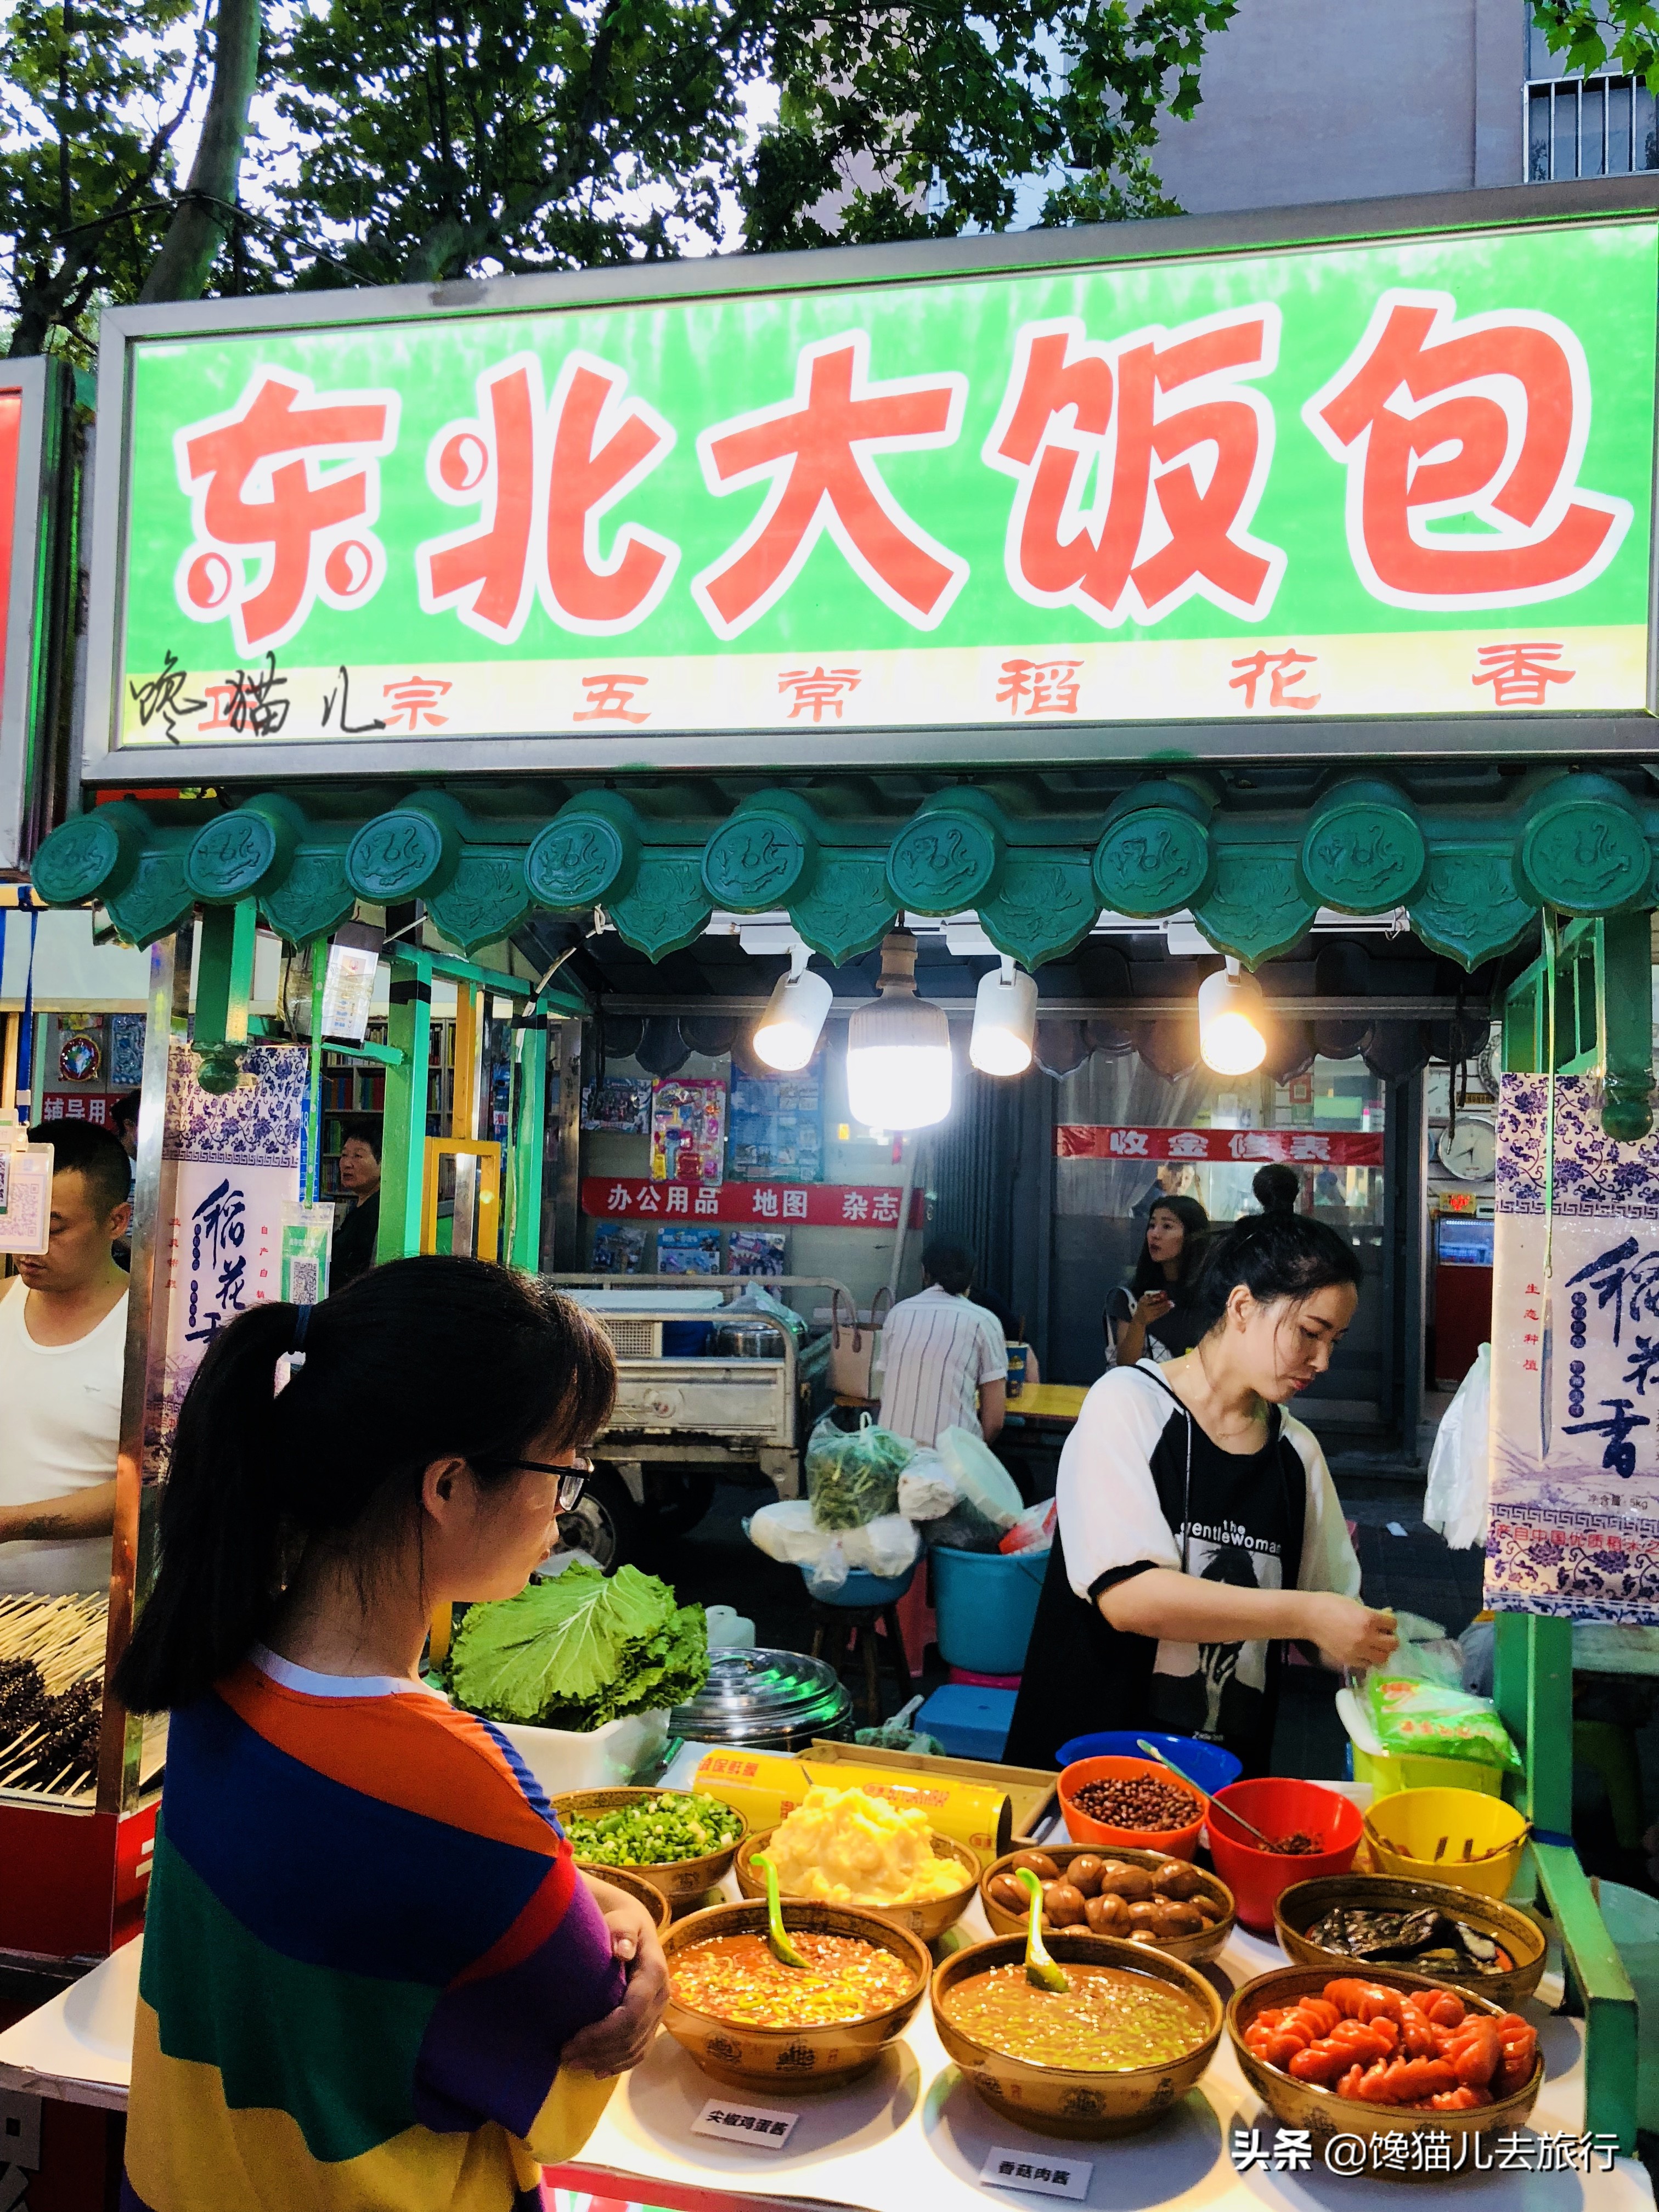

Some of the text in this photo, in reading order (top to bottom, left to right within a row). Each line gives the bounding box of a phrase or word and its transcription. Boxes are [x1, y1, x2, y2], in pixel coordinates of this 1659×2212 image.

[177, 289, 1632, 656] 东北大饭包
[198, 644, 1576, 732] 正宗五常稻花香
[44, 1098, 120, 1125] 辅导用
[607, 1184, 900, 1222] 办公用品 地图 杂志
[1223, 1520, 1245, 1534] the
